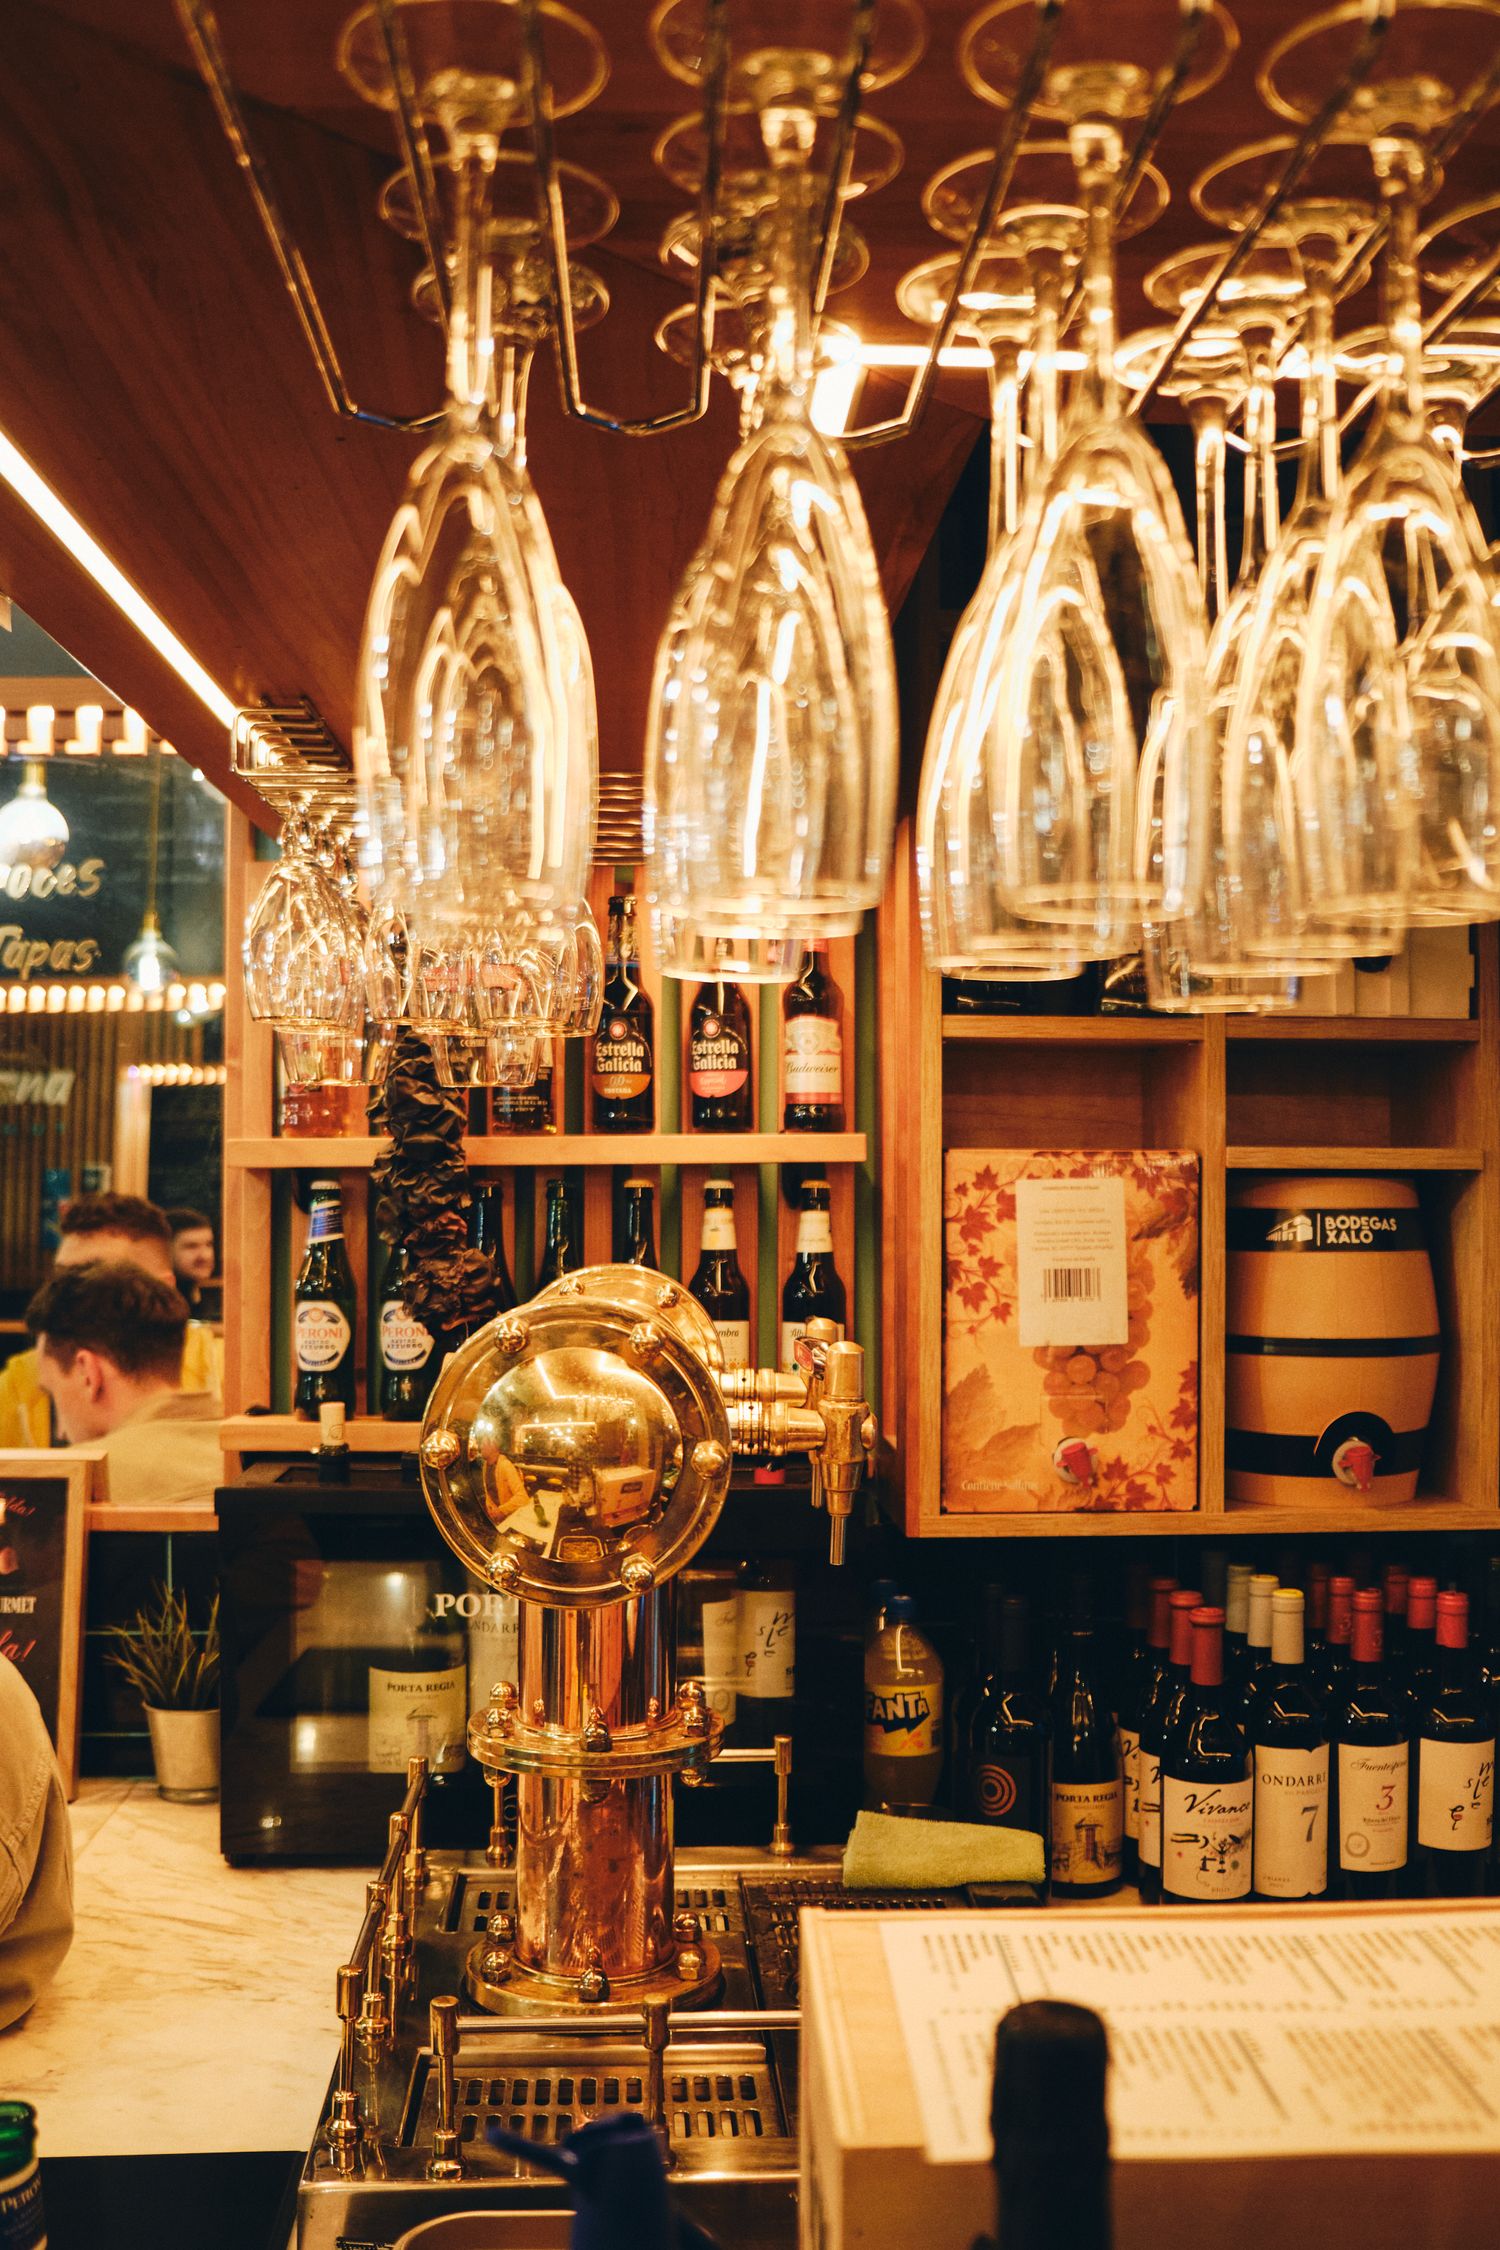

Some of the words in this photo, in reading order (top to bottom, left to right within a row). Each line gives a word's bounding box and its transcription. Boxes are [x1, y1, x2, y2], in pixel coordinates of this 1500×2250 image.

[596, 1042, 644, 1057] Estrella
[692, 1039, 739, 1055] Estrella
[597, 1057, 642, 1072] Galicia
[693, 1054, 737, 1070] Galicia
[1325, 1216, 1398, 1232] BODEGAS
[387, 1682, 423, 1693] PORTA
[1375, 1784, 1397, 1811] 3
[1300, 1804, 1320, 1843] 7
